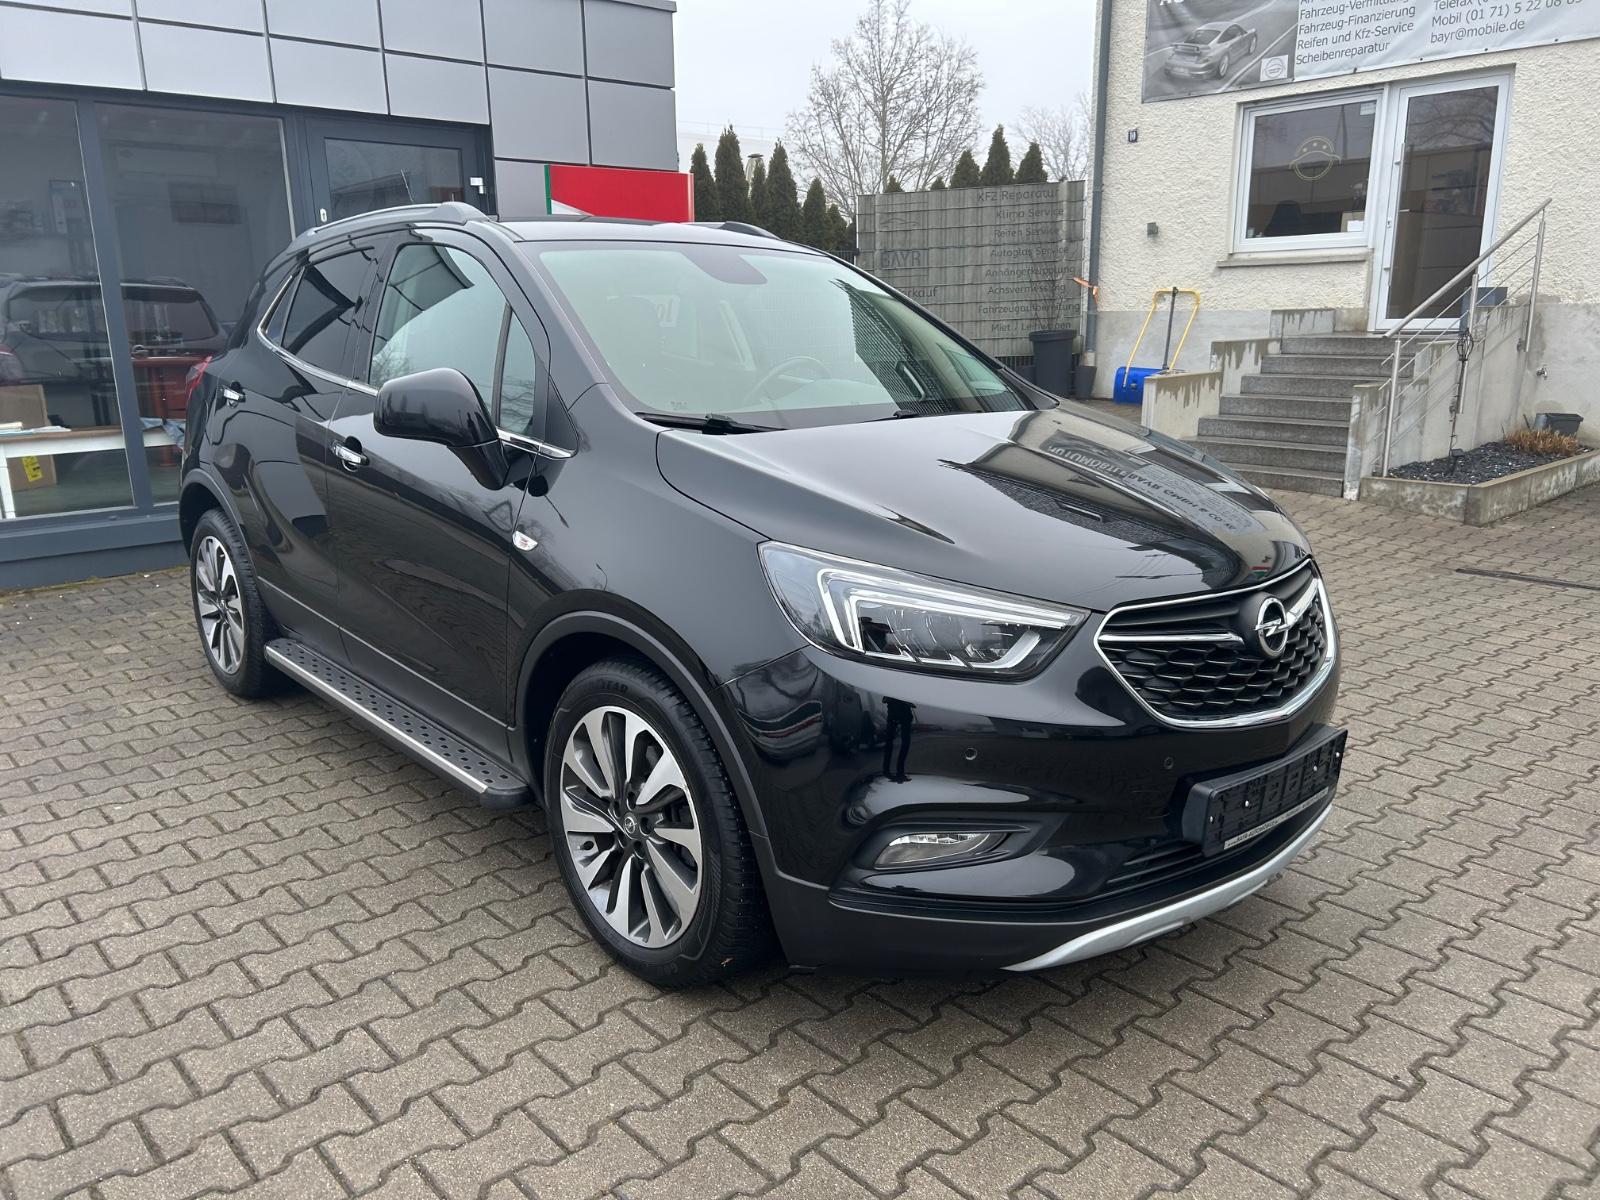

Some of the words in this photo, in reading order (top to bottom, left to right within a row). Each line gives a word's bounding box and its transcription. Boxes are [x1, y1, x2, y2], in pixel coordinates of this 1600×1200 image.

[1300, 0, 1409, 19] Fahrzeug-Vermitt
[1431, 12, 1462, 27] Mobil
[1466, 8, 1484, 24] (01
[1490, 4, 1509, 18] 71)
[1514, 2, 1521, 13] 5
[1526, 0, 1541, 11] 22
[1299, 6, 1416, 35] Fahrzeug-Finanzierung
[1297, 37, 1328, 50] Reifen
[1332, 30, 1352, 45] und
[1355, 22, 1414, 41] Kfz-Service
[1430, 19, 1525, 44] bayr@mobile.de
[1296, 41, 1390, 65] Scheibenreparatur
[977, 191, 998, 202] KFZ
[1002, 189, 1060, 202] Reparatur
[996, 209, 1025, 219] Klima
[1028, 208, 1064, 218] Service
[994, 228, 1023, 238] Reifen
[1026, 227, 1061, 237] Service
[880, 250, 921, 268] BAYR
[990, 247, 1033, 258] Autoglas
[1036, 246, 1069, 255] Service
